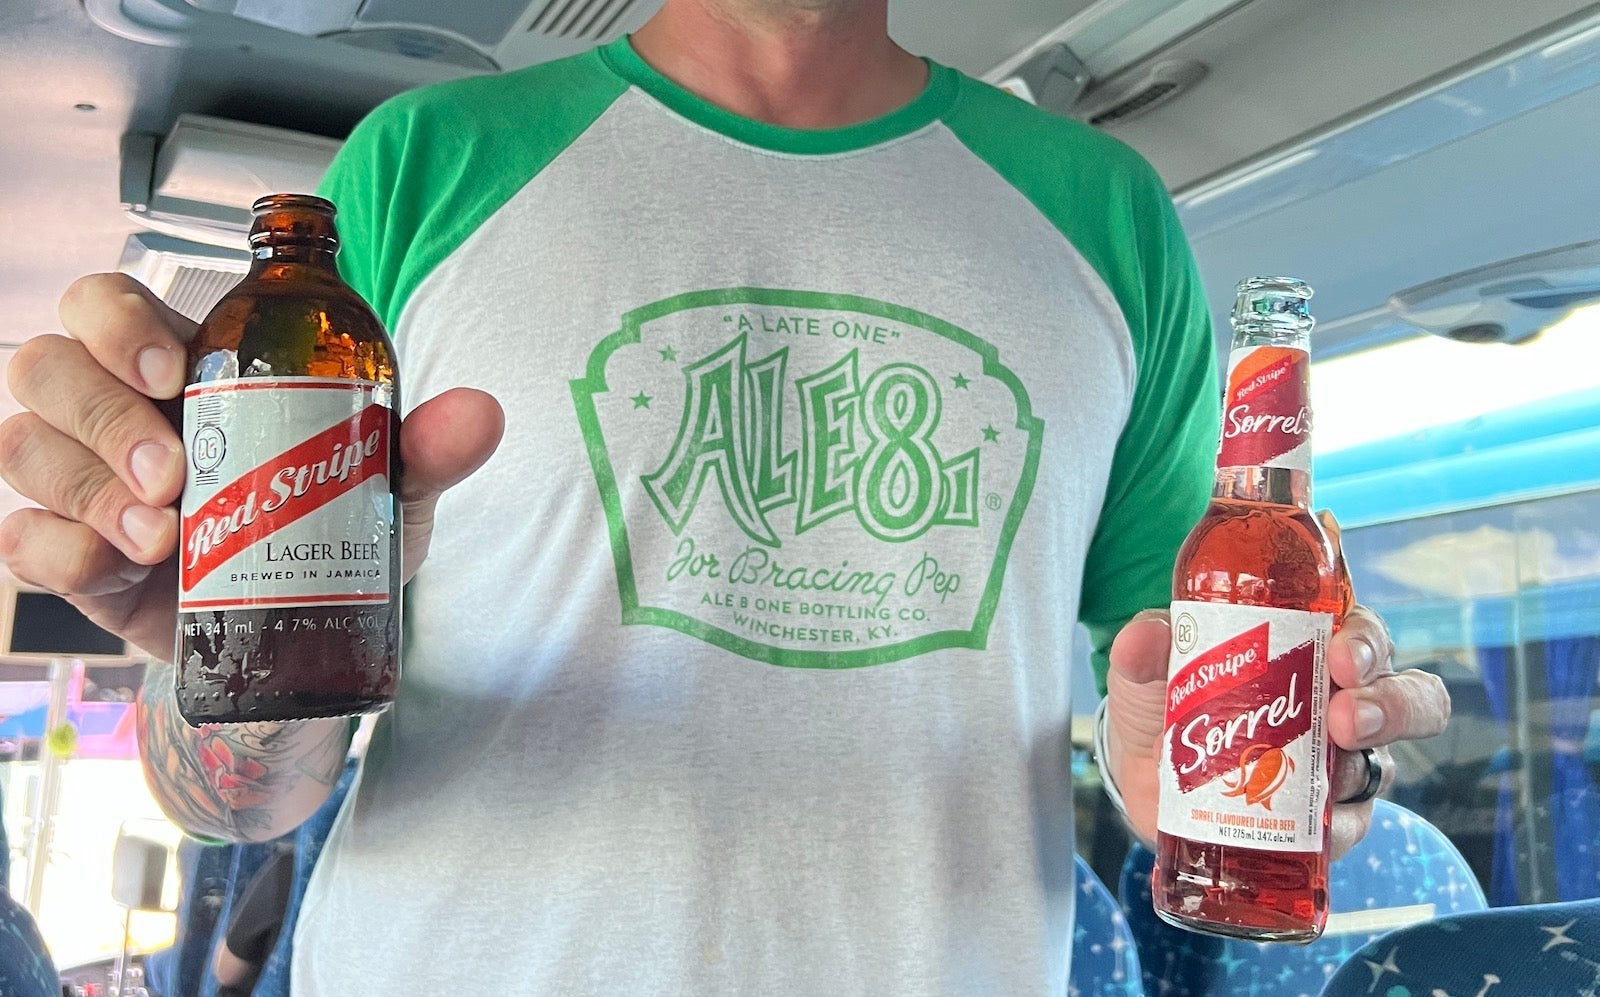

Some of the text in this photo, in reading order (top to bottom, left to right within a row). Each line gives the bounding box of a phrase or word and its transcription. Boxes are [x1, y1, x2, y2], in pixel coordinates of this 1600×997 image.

[761, 315, 820, 336] LATE
[1236, 367, 1287, 401] Red Stripe
[1225, 404, 1303, 438] Sorrel
[187, 428, 380, 570] Red Stripe
[266, 540, 381, 562] LAGER BEER
[231, 569, 381, 582] BREWED IN JAMAICA
[729, 544, 896, 607] Bracing
[904, 551, 961, 604] Pep
[700, 592, 734, 608] ALE
[755, 598, 792, 614] ONE
[800, 602, 891, 621] BOTTLING
[898, 607, 931, 622] CO.
[184, 622, 202, 638] NET
[206, 621, 229, 636] 341
[733, 611, 898, 643] WINCHESTER, KY.
[1169, 647, 1257, 713] Red Stripe
[1180, 672, 1303, 775] Sorrel
[1191, 808, 1296, 831] SORREL FLAVOURED LAGER BEER
[1219, 826, 1231, 837] NET
